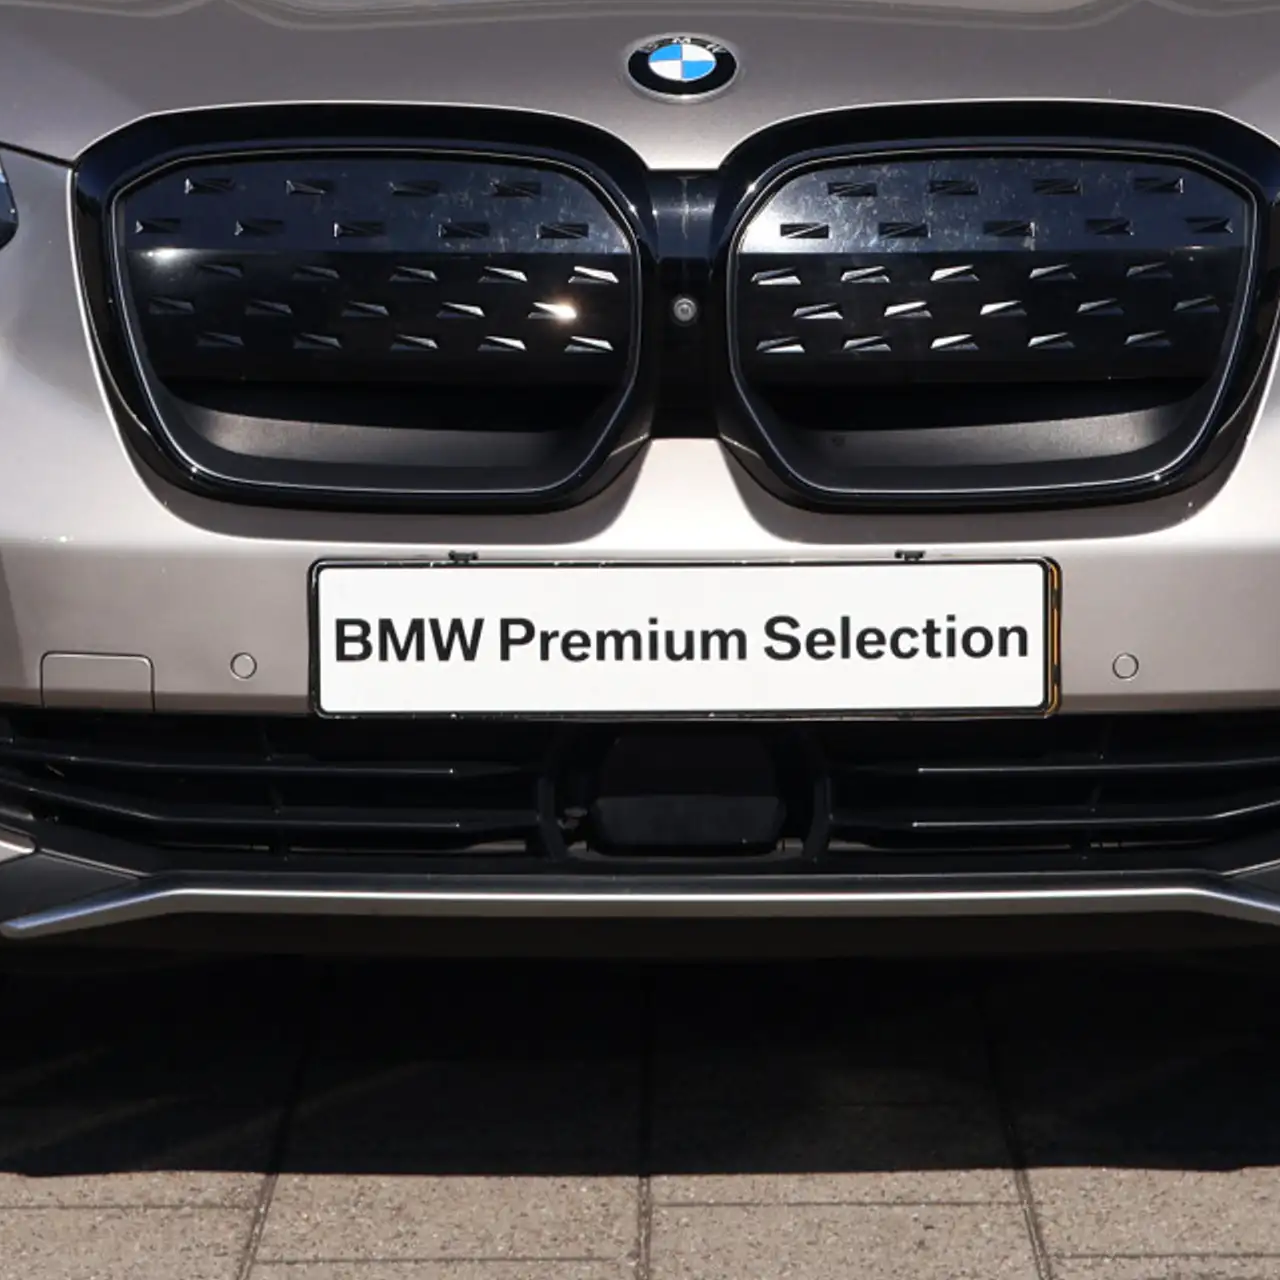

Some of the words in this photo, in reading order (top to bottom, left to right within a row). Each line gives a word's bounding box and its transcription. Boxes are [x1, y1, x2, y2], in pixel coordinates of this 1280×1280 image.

[334, 617, 485, 662] BMW
[499, 616, 748, 662] Premium
[763, 614, 1028, 660] Selection
